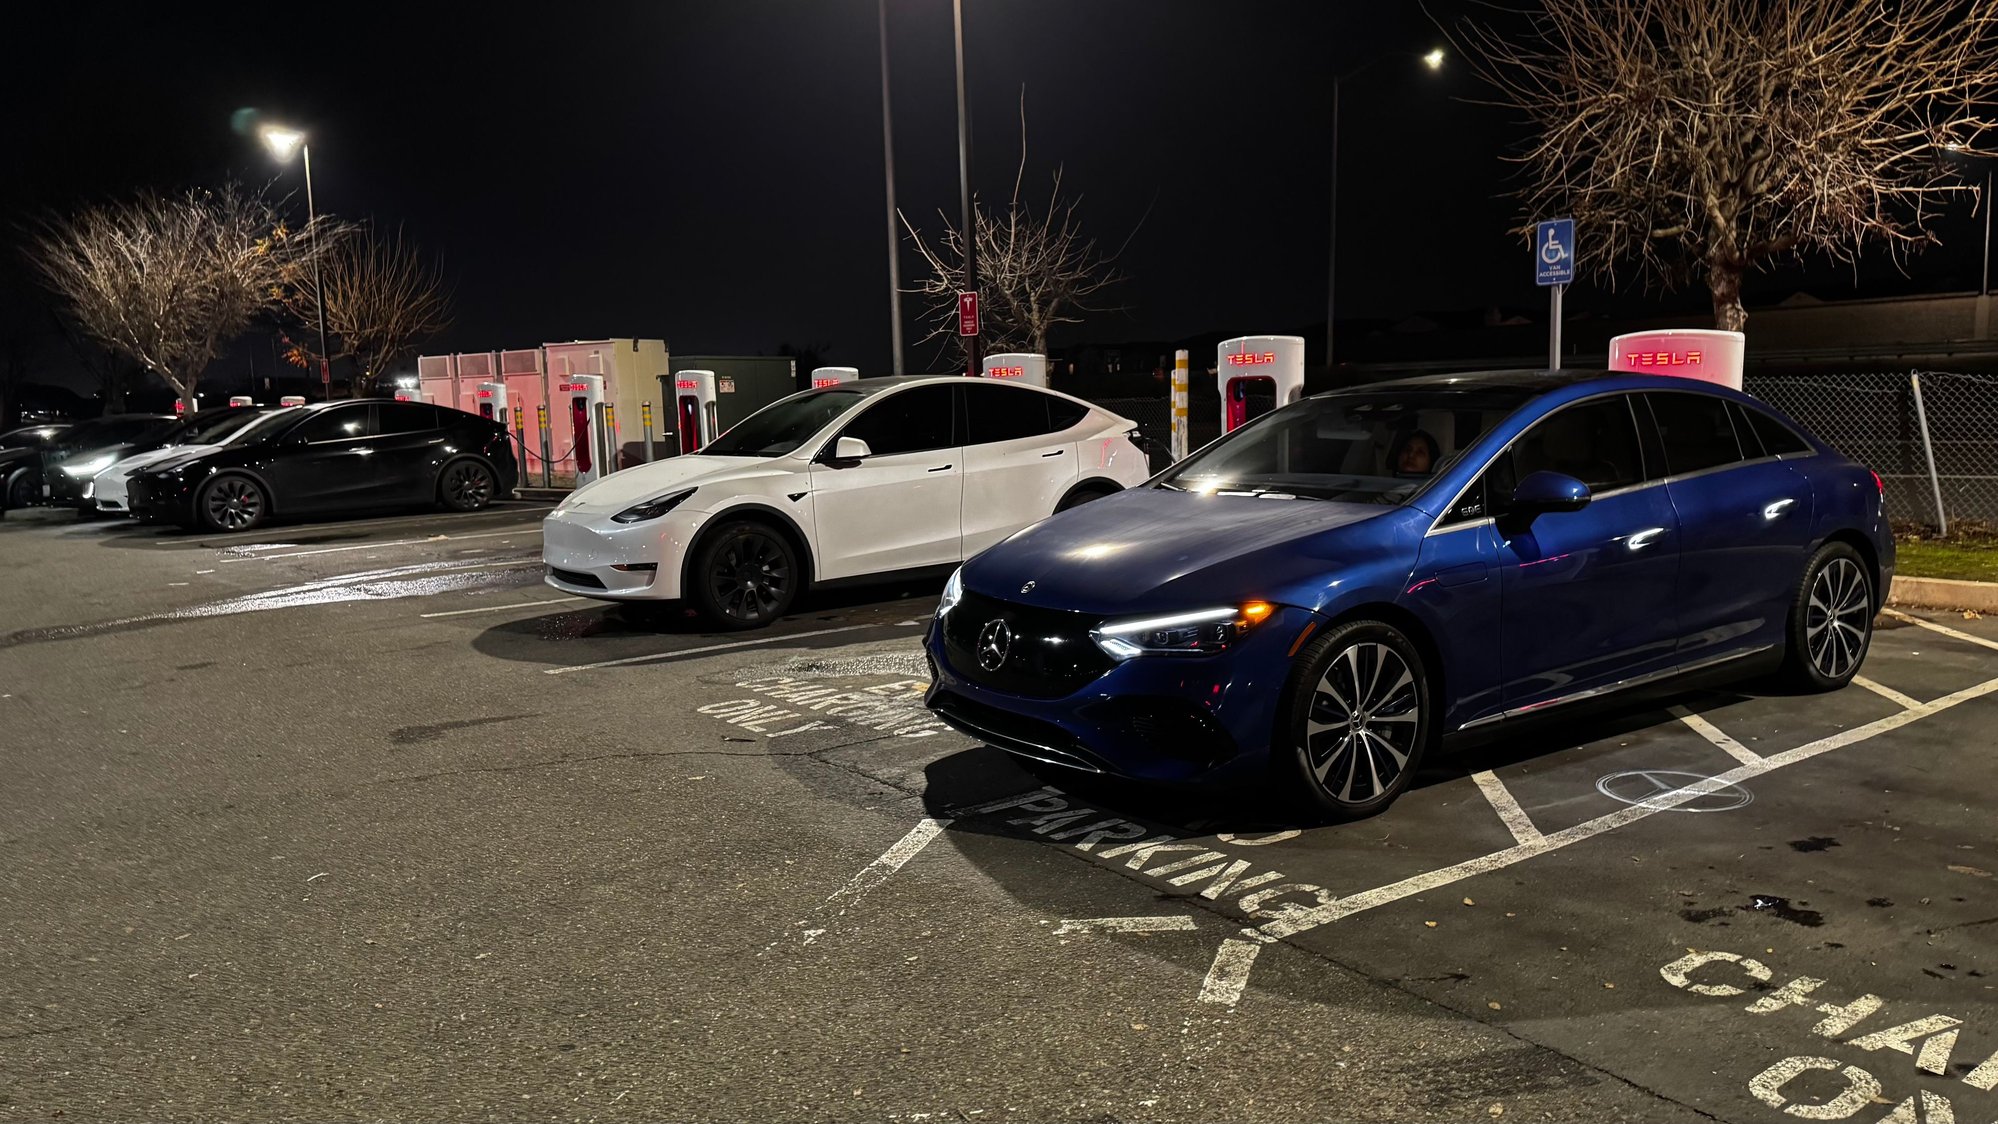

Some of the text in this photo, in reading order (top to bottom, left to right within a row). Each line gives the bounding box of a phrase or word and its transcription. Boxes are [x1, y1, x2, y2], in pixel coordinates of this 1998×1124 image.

[1539, 269, 1570, 277] ACCESSIBLE
[1227, 351, 1274, 365] TESLA
[1627, 351, 1701, 366] TESLA
[988, 367, 1022, 377] TESLA
[1461, 504, 1481, 517] EQE
[697, 699, 840, 738] ONLY
[985, 786, 1337, 930] PARKING
